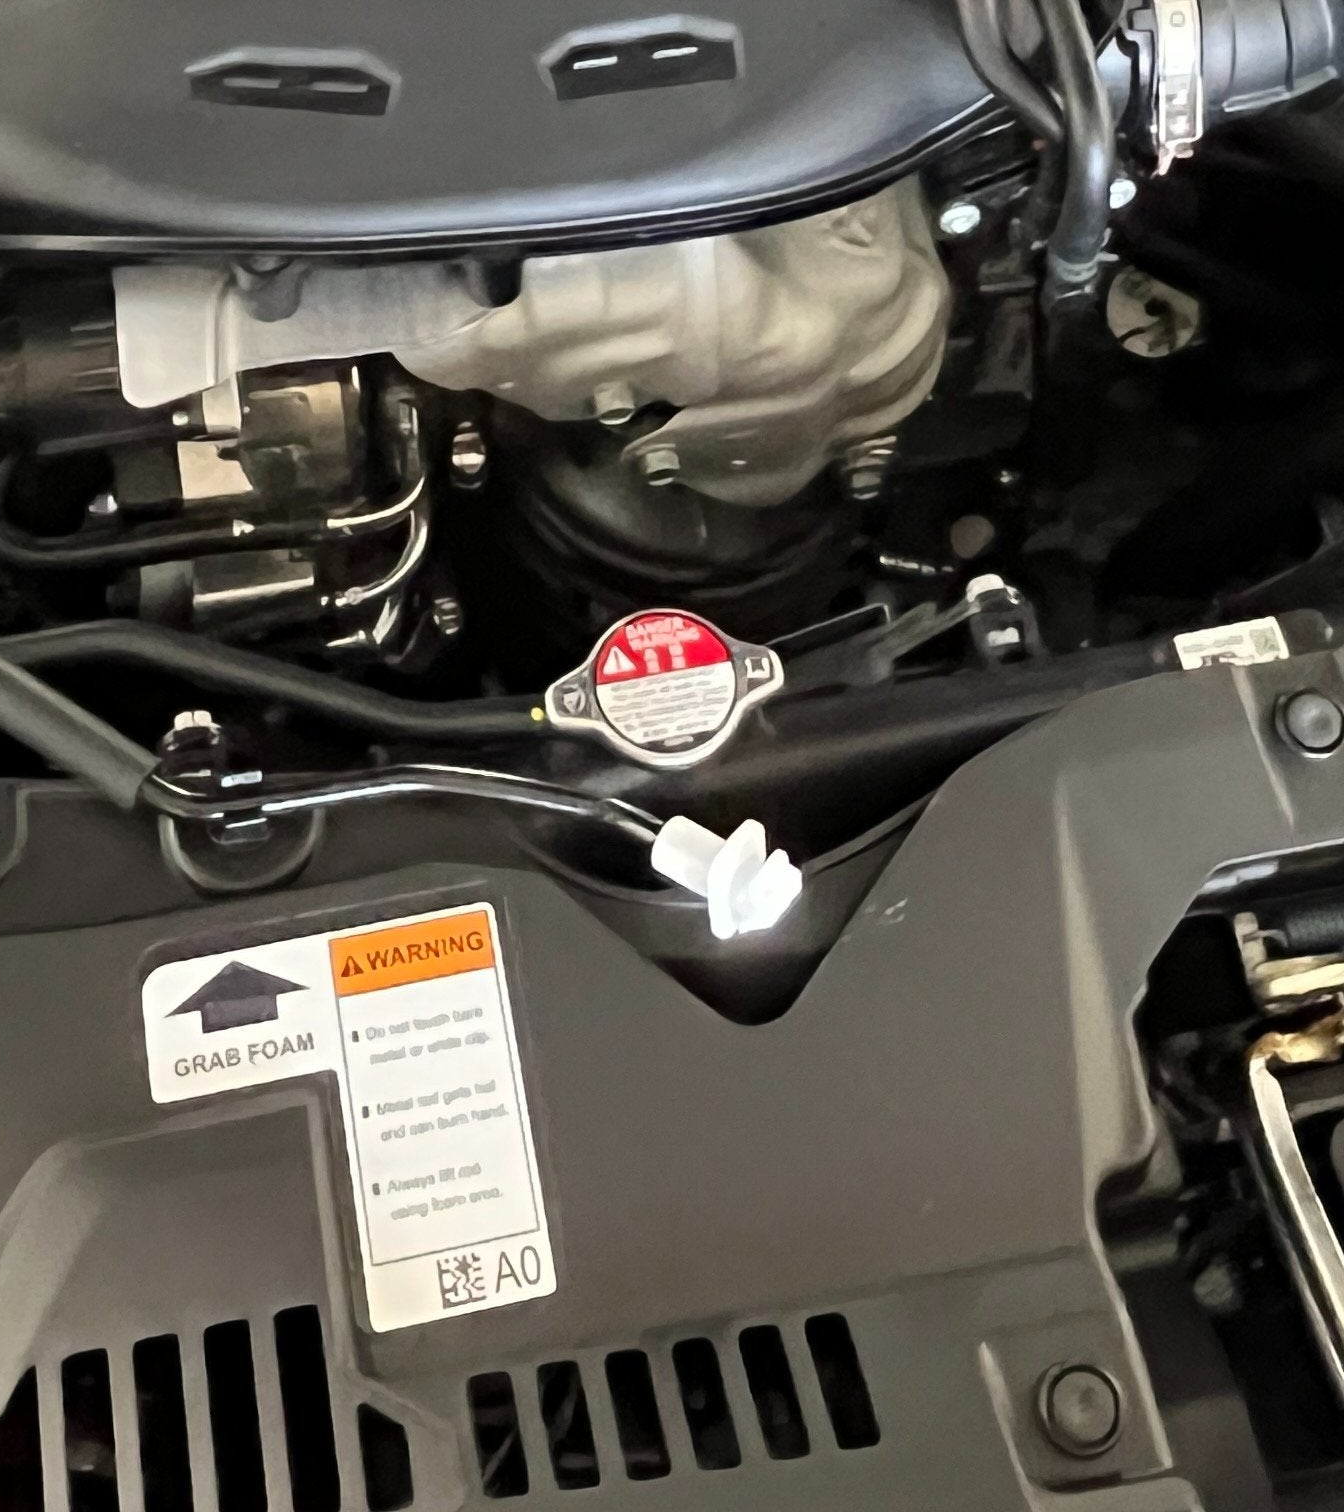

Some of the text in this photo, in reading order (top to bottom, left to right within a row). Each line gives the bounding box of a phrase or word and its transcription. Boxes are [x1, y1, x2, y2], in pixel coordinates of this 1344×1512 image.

[365, 930, 485, 971] WARNING
[173, 1031, 316, 1078] GRAB FOAM
[494, 1244, 542, 1295] A0
